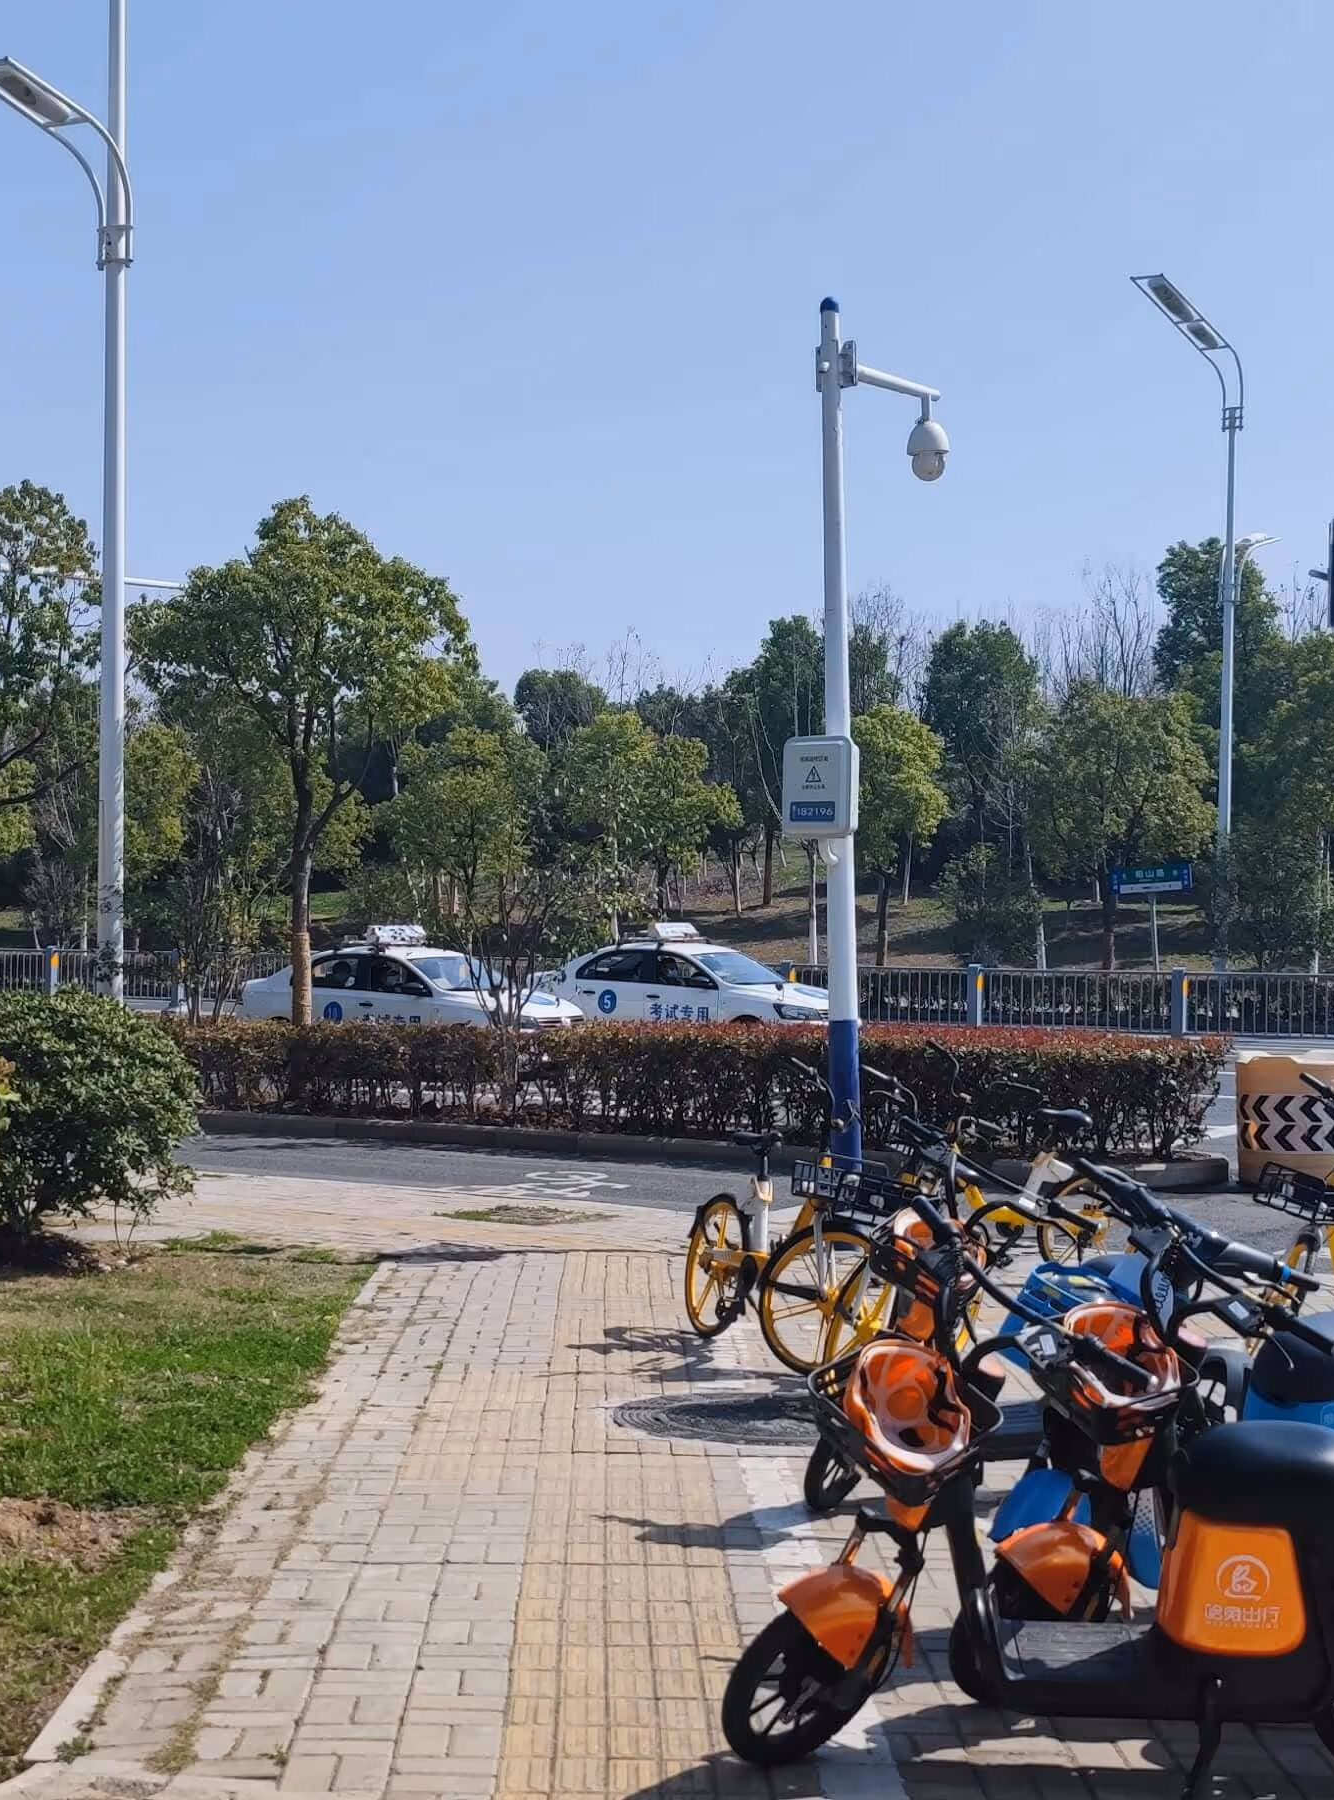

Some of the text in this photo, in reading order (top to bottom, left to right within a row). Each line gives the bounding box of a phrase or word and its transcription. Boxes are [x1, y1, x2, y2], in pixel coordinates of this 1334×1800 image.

[603, 995, 611, 1009] 5
[649, 1003, 709, 1021] 考试专用
